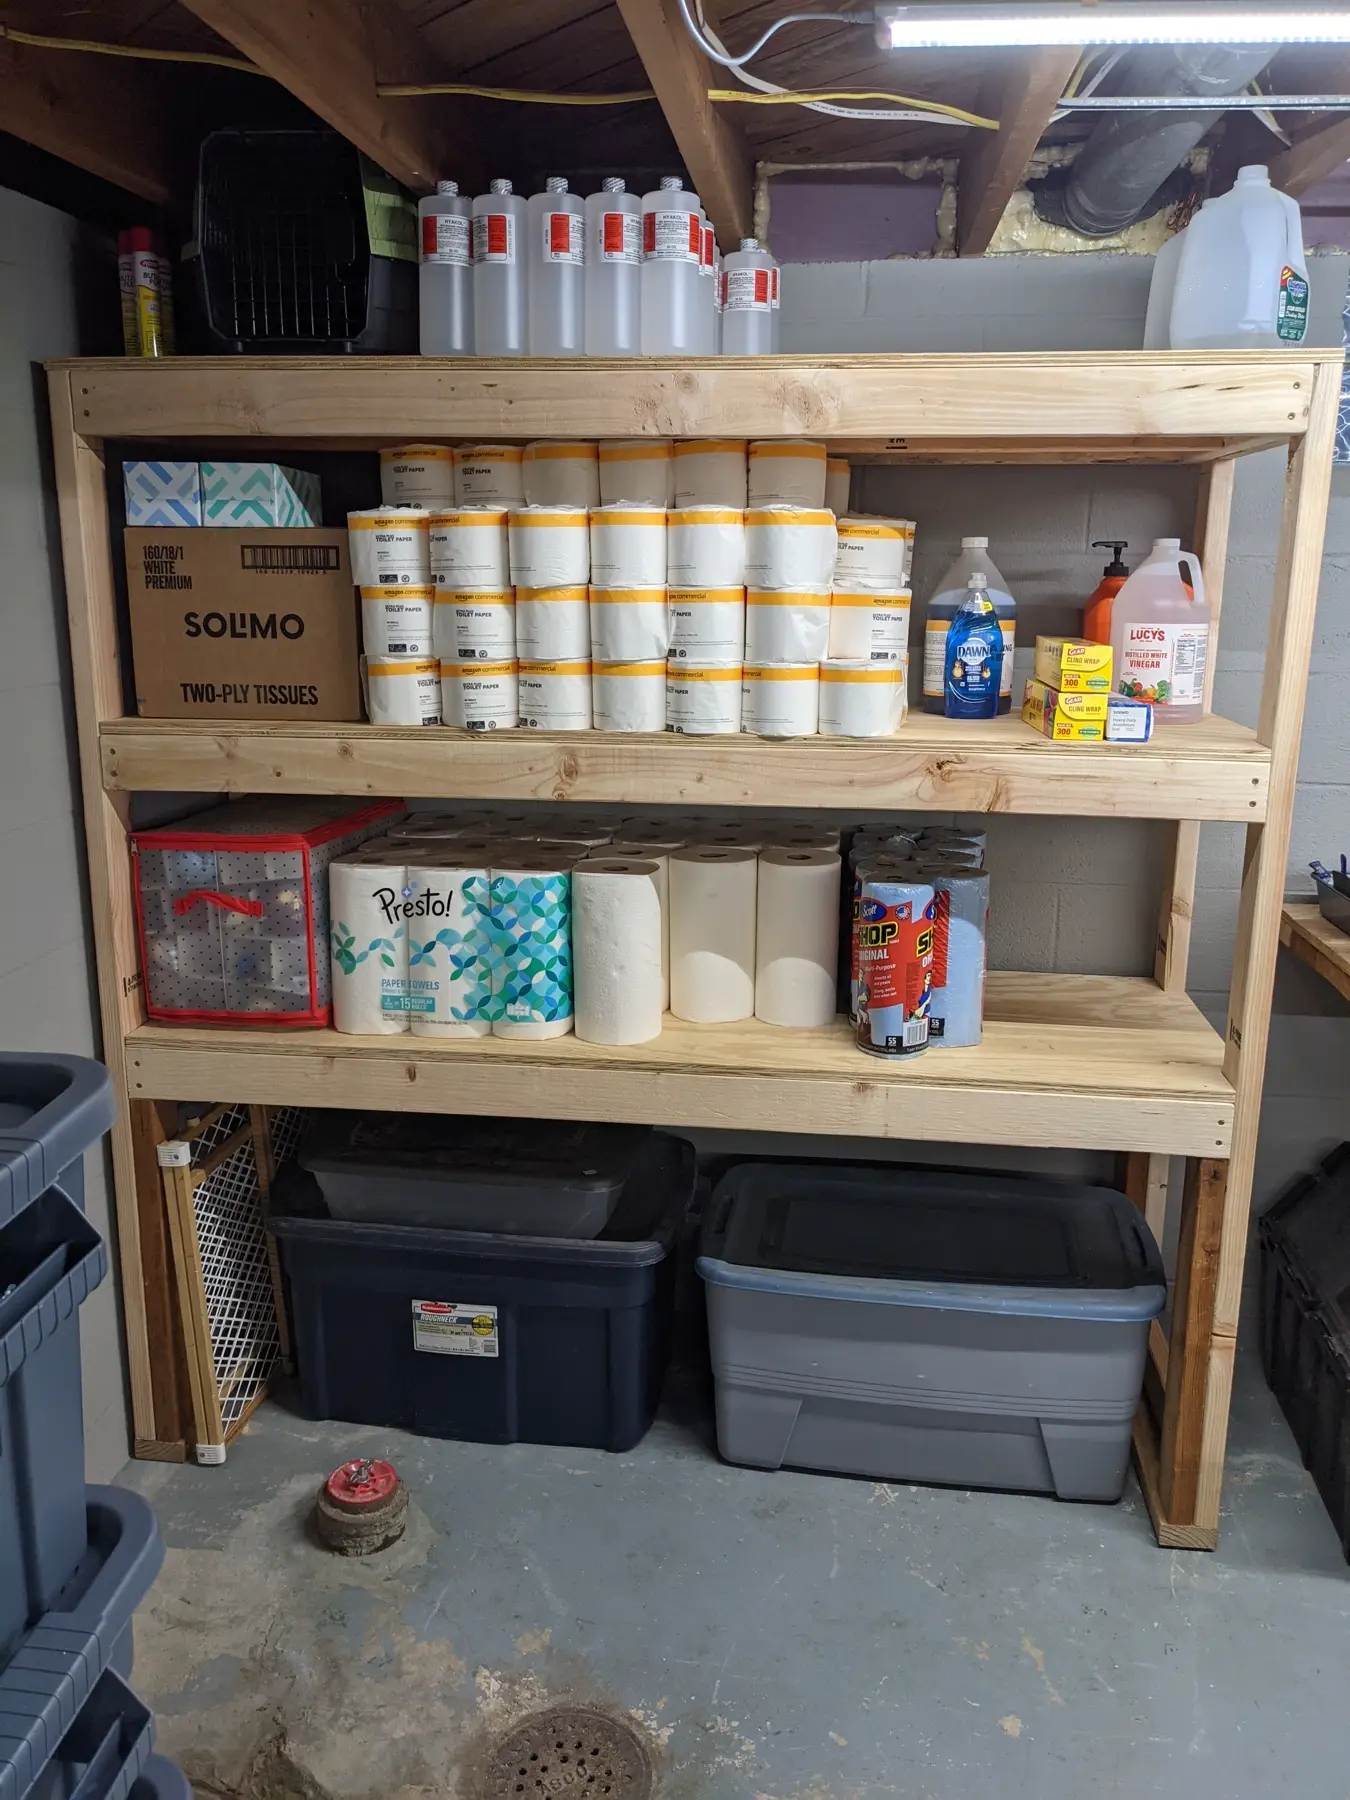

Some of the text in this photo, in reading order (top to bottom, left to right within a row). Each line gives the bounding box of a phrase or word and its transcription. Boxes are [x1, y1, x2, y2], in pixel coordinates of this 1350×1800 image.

[374, 519, 394, 527] amazon
[142, 545, 184, 559] 160/18/1
[143, 560, 176, 575] WHITE
[145, 575, 193, 590] PREMIUM
[455, 594, 474, 602] amazon
[183, 611, 305, 640] SOLIMO
[1130, 628, 1165, 641] LUCY'S
[958, 646, 990, 658] DAWN
[1068, 648, 1085, 656] GLAD
[1124, 651, 1150, 659] DISTILLED
[1066, 656, 1083, 664] CLING
[1129, 660, 1161, 669] VINEGAR
[462, 667, 481, 675] amazon
[1064, 678, 1079, 686] 300
[180, 682, 319, 706] TWO-PLY TISSUES
[1065, 696, 1082, 704] GLAD
[372, 887, 454, 925] Presto!
[862, 903, 878, 918] Scott
[859, 921, 899, 948] HOP
[381, 978, 440, 990] PAPER TOWELS
[400, 997, 411, 1009] 15
[931, 1018, 940, 1026] 55
[420, 1313, 458, 1324] ROUGHNECK
